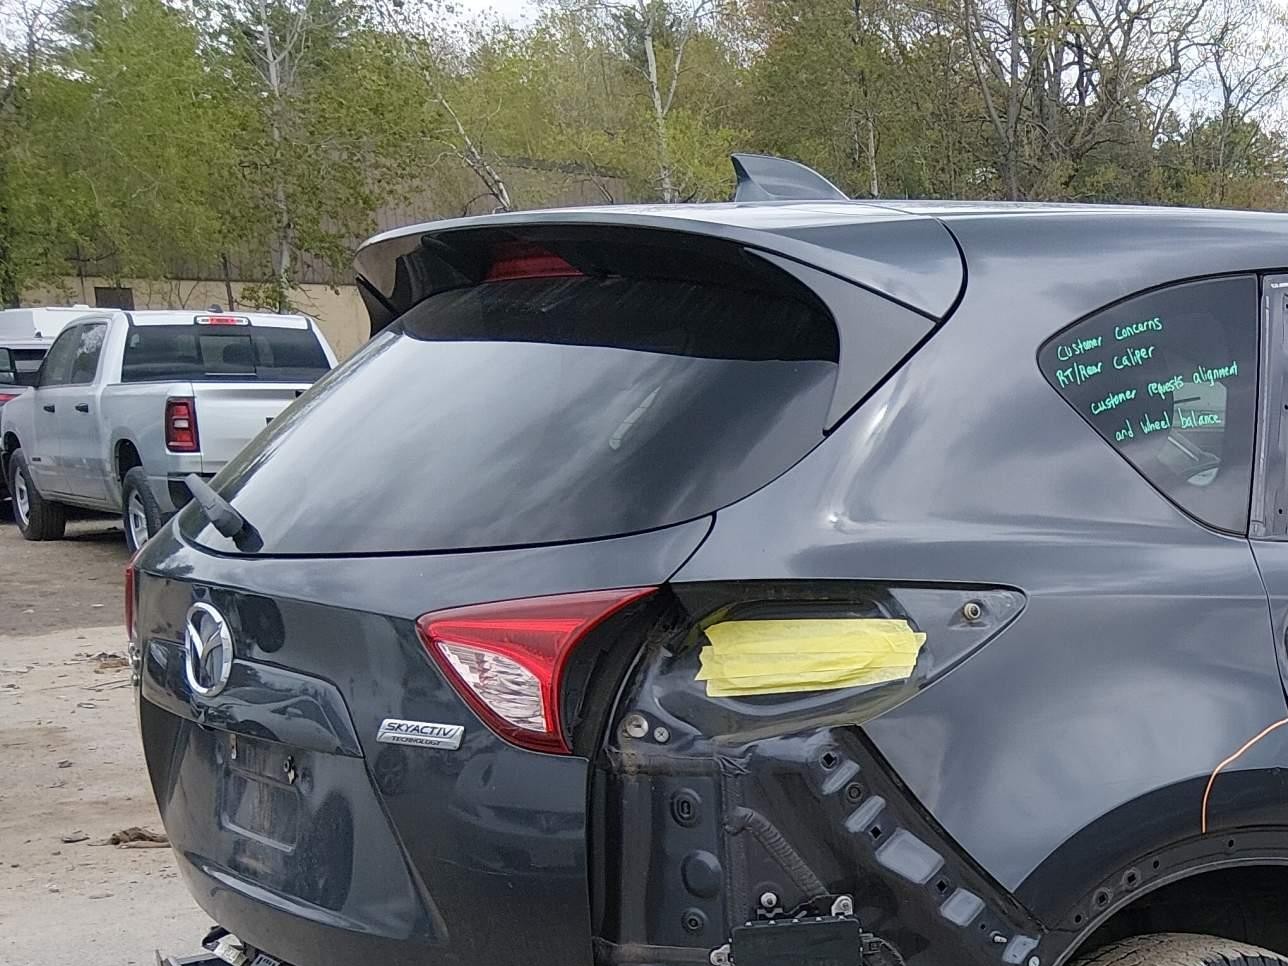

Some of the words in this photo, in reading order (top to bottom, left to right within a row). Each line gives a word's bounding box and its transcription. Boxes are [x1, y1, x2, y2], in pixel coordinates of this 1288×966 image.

[1057, 336, 1102, 361] Customer
[1115, 317, 1162, 340] Concerns
[1147, 375, 1184, 399] requests
[1193, 361, 1238, 387] alignment
[1115, 419, 1134, 442] and
[1178, 408, 1221, 430] balance
[385, 722, 454, 737] SKYACTIV
[391, 735, 441, 746] TECHNOLOGY
